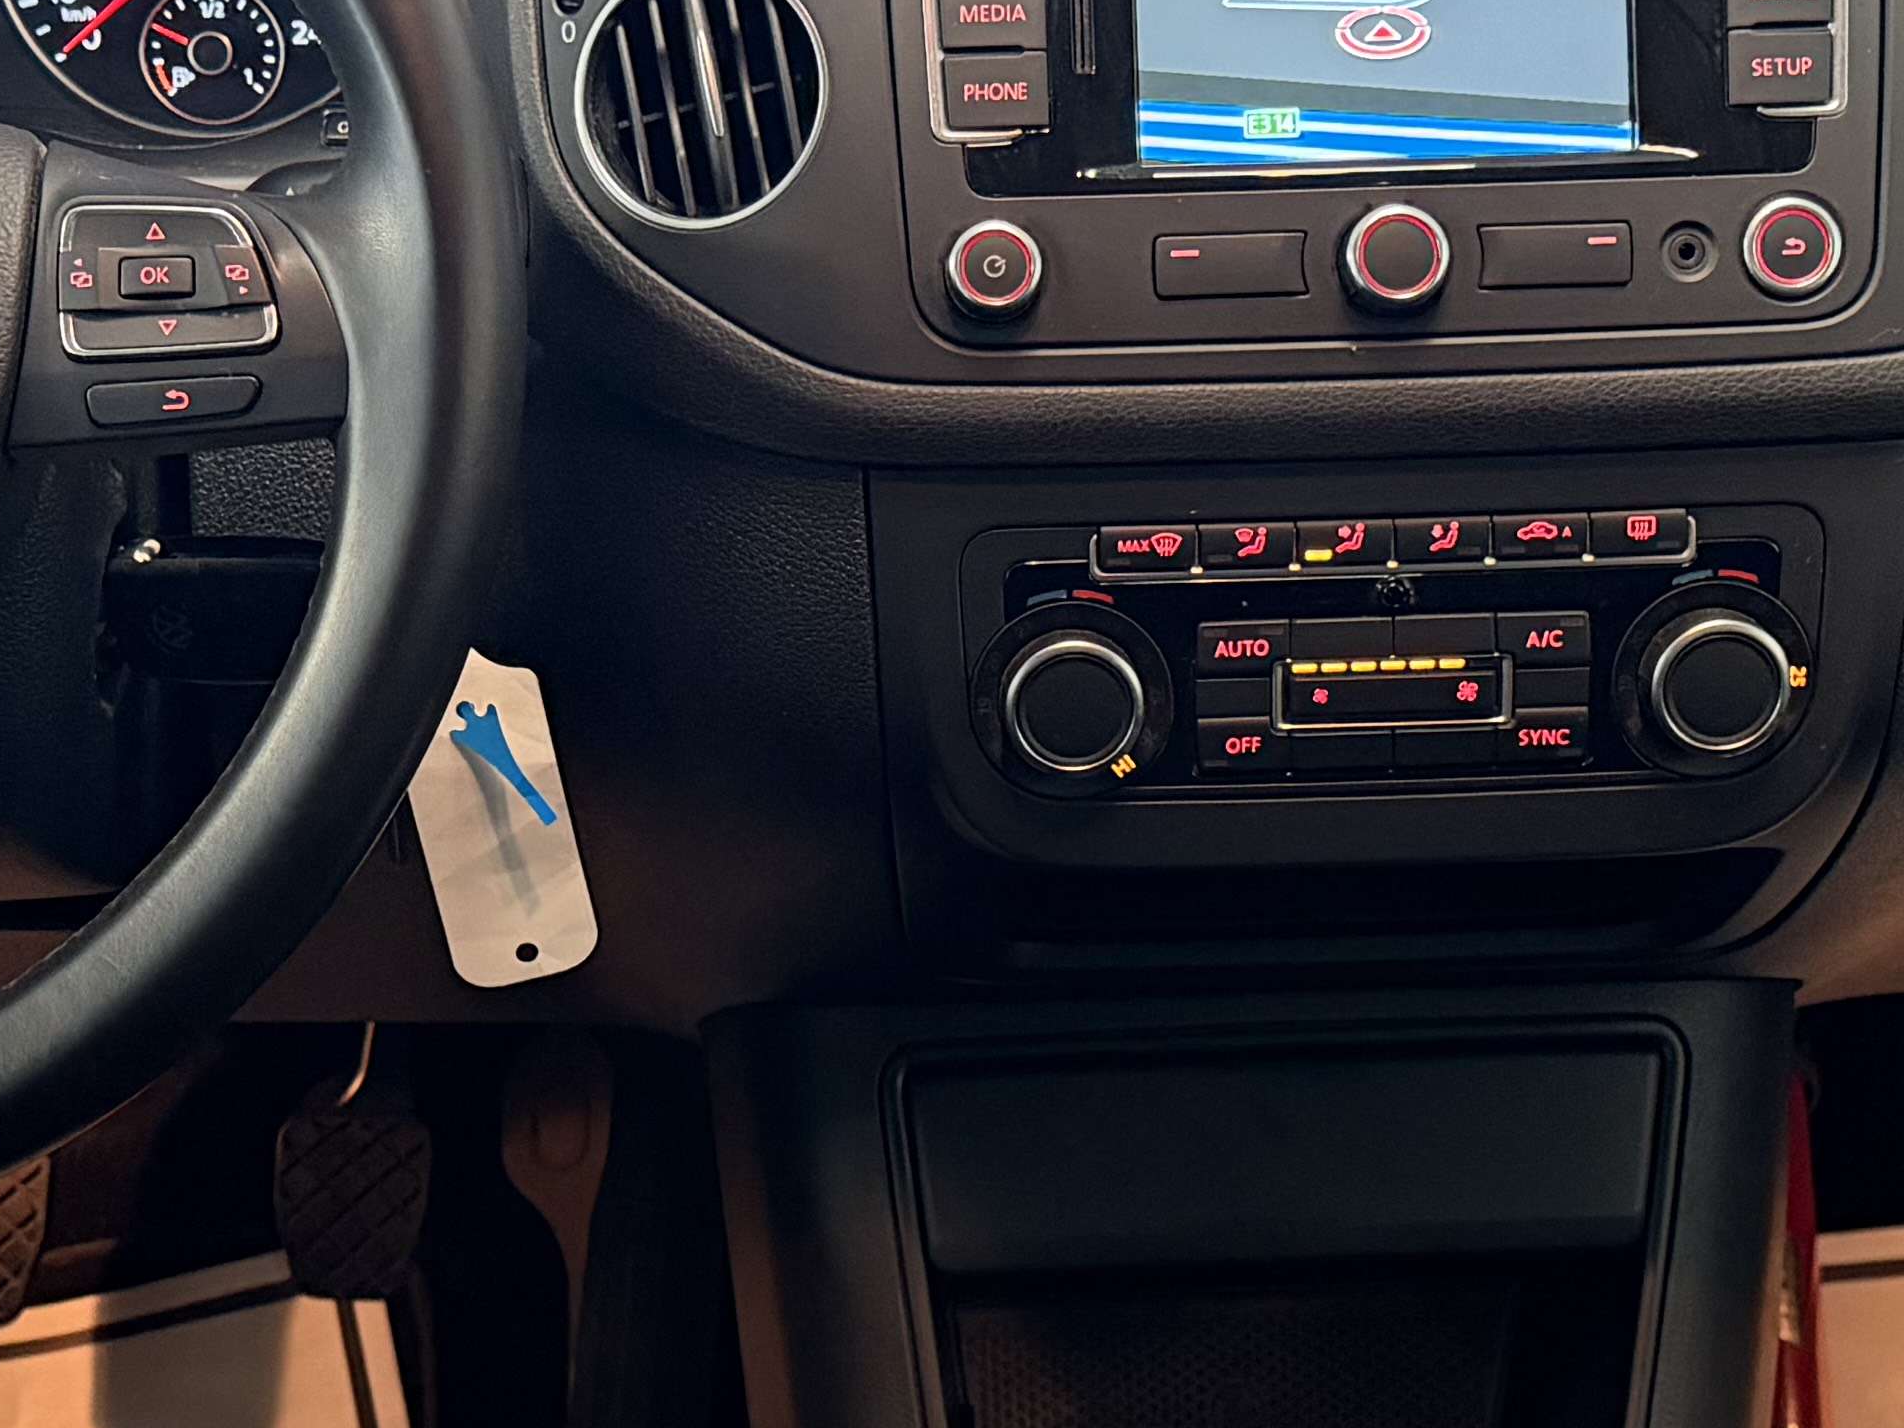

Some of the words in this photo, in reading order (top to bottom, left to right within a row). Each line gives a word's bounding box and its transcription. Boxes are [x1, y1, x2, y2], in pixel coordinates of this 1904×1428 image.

[959, 3, 1027, 24] MEDIA
[1751, 56, 1814, 77] SETUP
[963, 81, 1029, 102] PHONE
[1248, 113, 1296, 134] E314
[139, 265, 170, 285] OK
[1117, 539, 1151, 554] MAX
[1213, 639, 1270, 660] AUTO
[1525, 629, 1564, 650] A/C
[1224, 735, 1262, 757] OFF
[1517, 728, 1571, 748] SYNC
